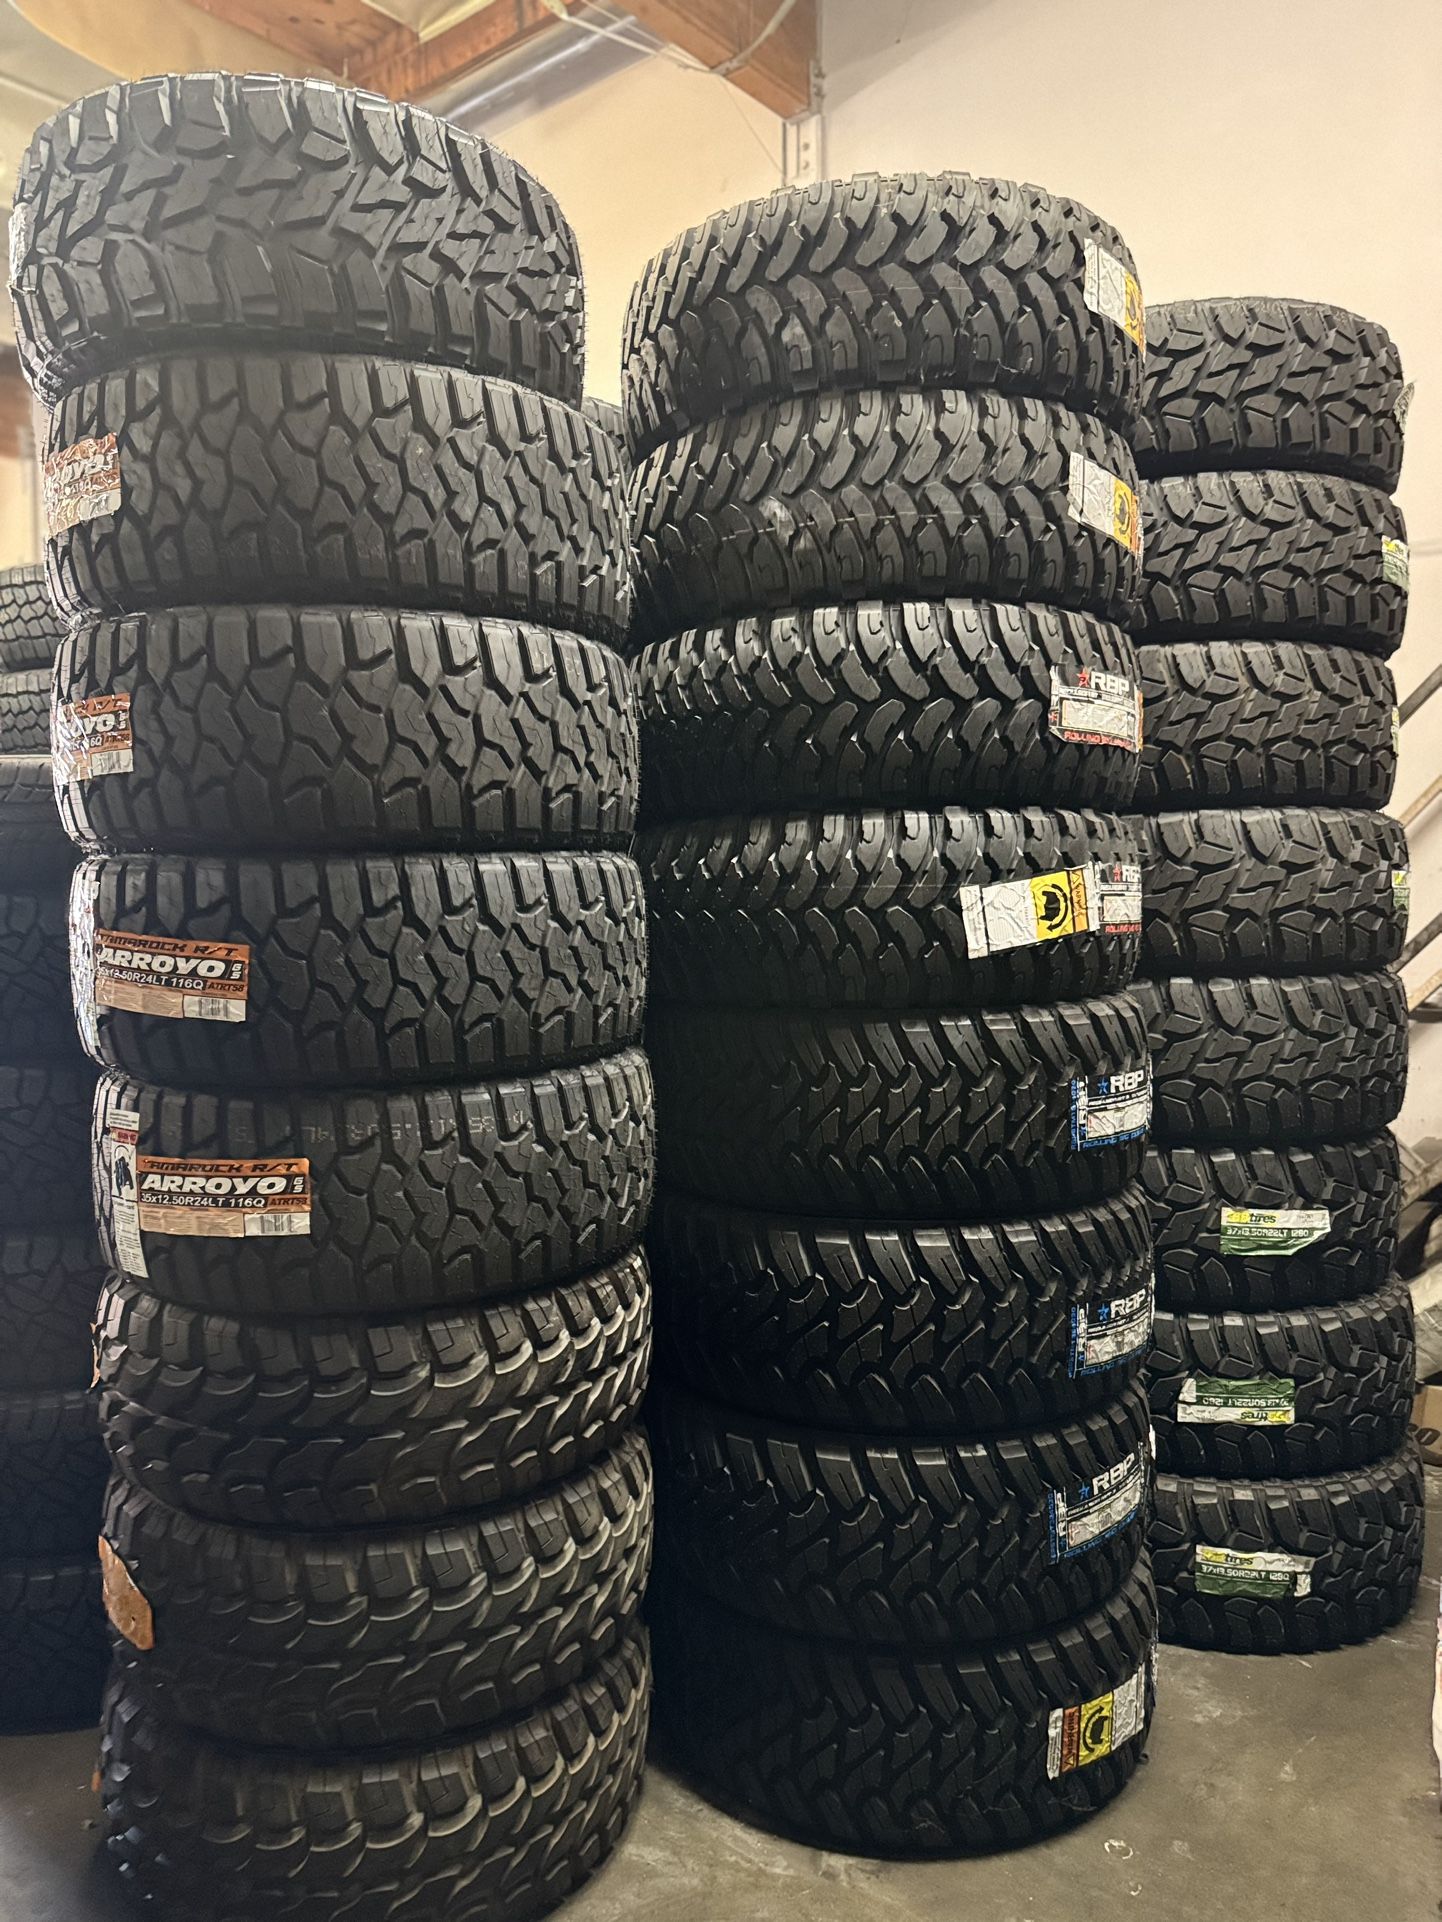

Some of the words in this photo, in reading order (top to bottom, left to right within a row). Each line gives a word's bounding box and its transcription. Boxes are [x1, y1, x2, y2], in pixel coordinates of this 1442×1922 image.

[1091, 671, 1130, 695] RBP
[194, 944, 238, 957] R/T
[99, 947, 226, 978] ARROYO
[171, 977, 204, 990] 116Q
[1110, 1069, 1144, 1093] RBP
[251, 1162, 300, 1173] R/T
[141, 1174, 287, 1195] ARROYO
[141, 1193, 224, 1207] 35x12.50R24LT
[229, 1196, 265, 1208] 116Q
[1110, 1288, 1146, 1319] RBP
[1092, 1452, 1135, 1496] RBP
